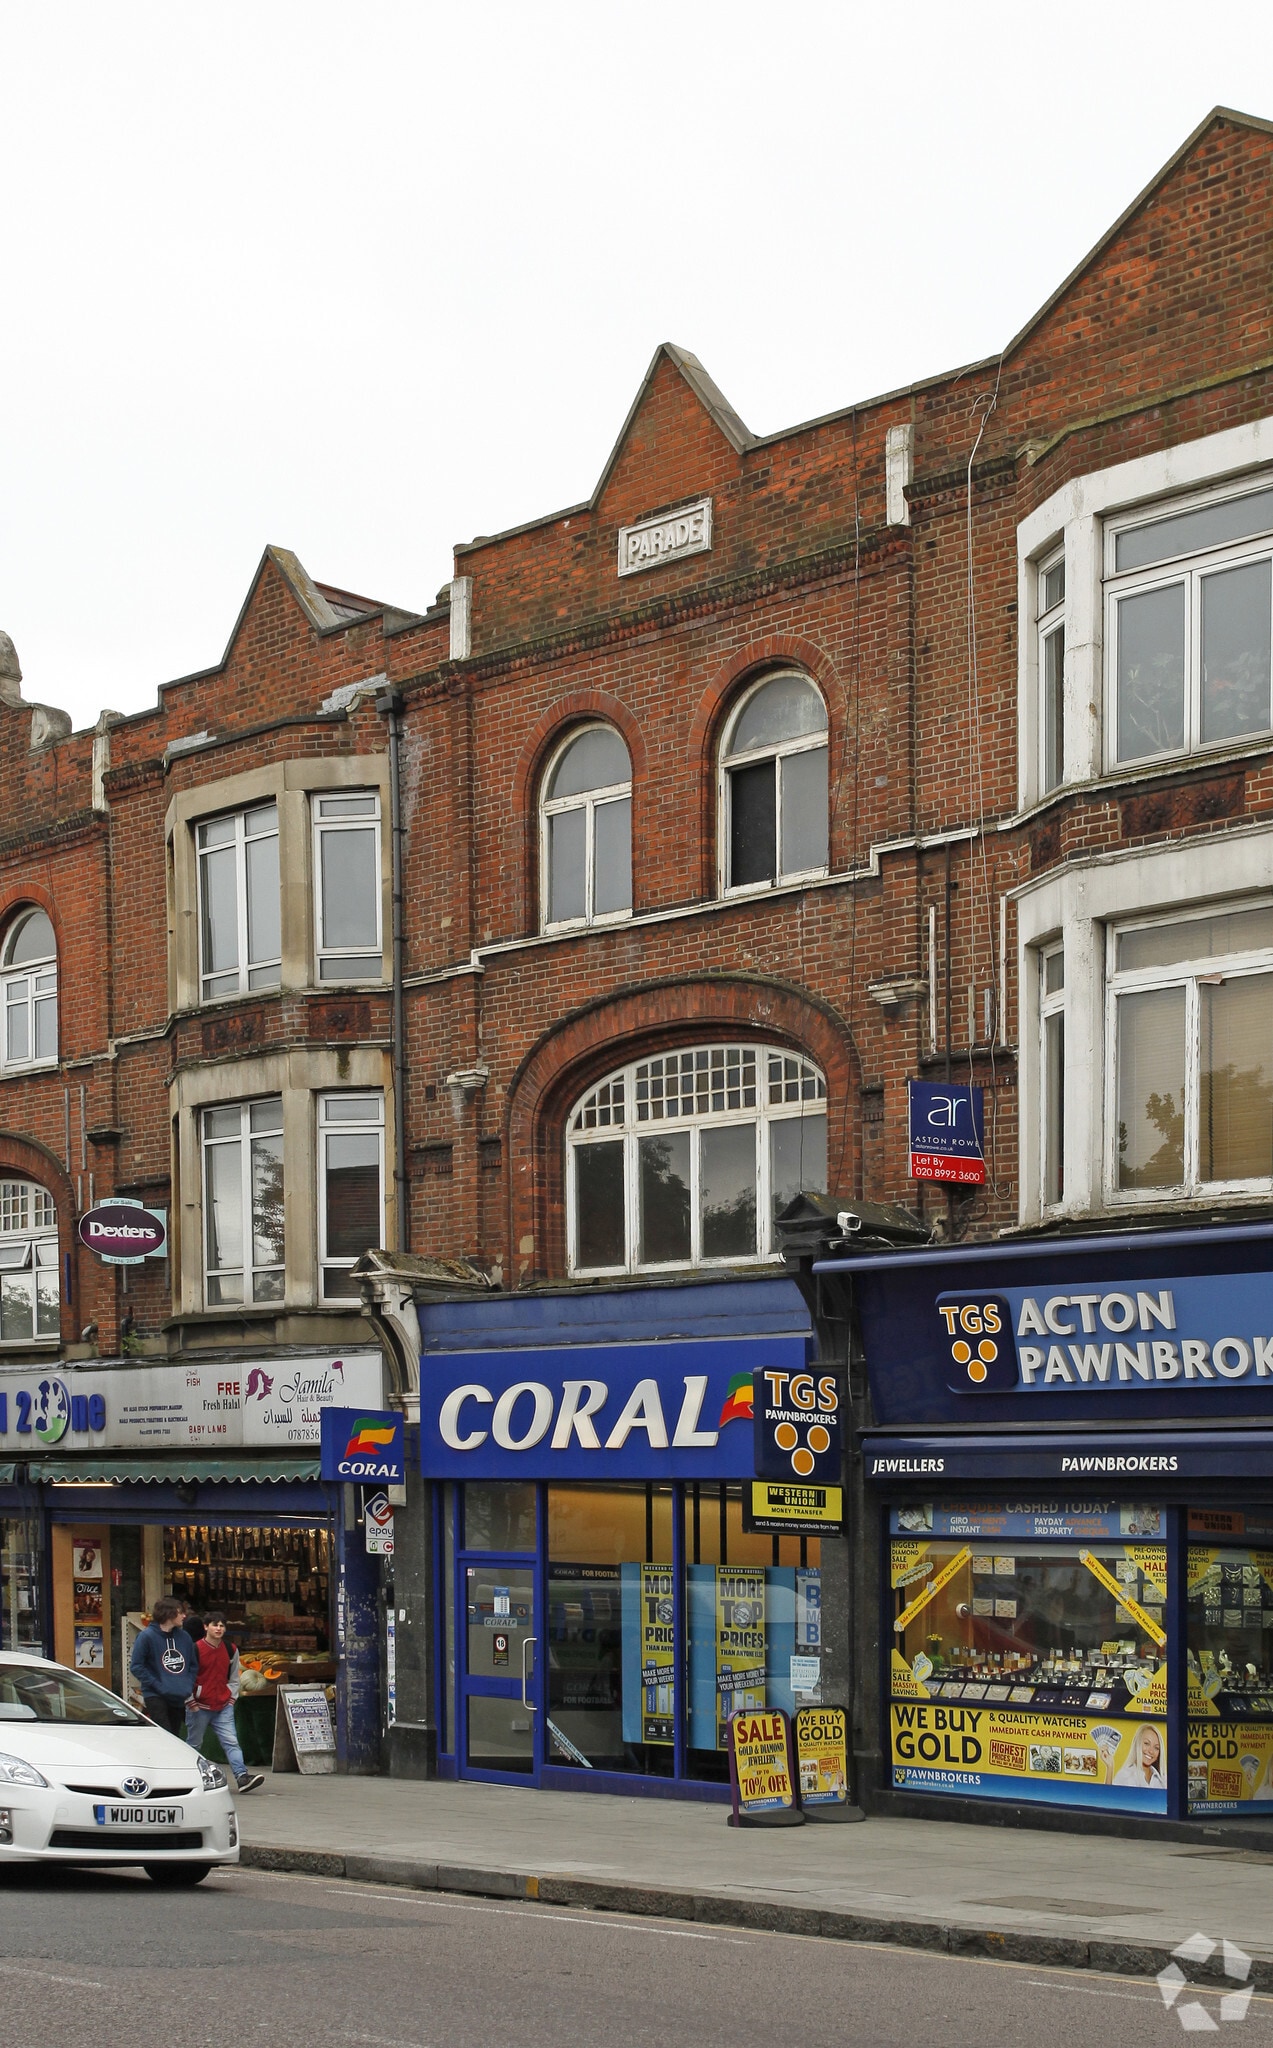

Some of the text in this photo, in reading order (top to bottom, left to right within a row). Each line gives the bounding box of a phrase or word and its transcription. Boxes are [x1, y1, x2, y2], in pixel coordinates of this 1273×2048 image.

[628, 516, 704, 565] PARADE
[915, 1136, 980, 1147] ASTON ROWE
[916, 1156, 944, 1167] Let By
[915, 1167, 980, 1181] 020 8992 3600
[89, 1221, 157, 1239] Dexters
[939, 1303, 1002, 1335] TGS
[1017, 1290, 1176, 1337] ACTON
[1018, 1335, 1273, 1384] PAWNBROK
[186, 1378, 201, 1387] FISH
[279, 1371, 335, 1403] Jamila
[764, 1370, 839, 1413] TGS
[297, 1394, 334, 1403] Hair & Beauty
[203, 1399, 241, 1411] Fresh Halal
[16, 1391, 31, 1433] 2
[439, 1375, 720, 1451] CORAL
[765, 1409, 837, 1425] PAWNBROKERS
[189, 1424, 227, 1434] BABY LAMB
[337, 1461, 400, 1477] CORAL
[872, 1458, 945, 1474] JEWELLERS
[1061, 1456, 1178, 1472] PAWNBROKERS
[768, 1487, 815, 1498] WESTERN
[784, 1496, 815, 1506] UNION
[771, 1507, 823, 1516] MONEY TRANSFER
[1005, 1503, 1059, 1514] CASHED
[1065, 1503, 1110, 1514] TODAY
[1034, 1518, 1064, 1526] PAYDAY
[1191, 1512, 1232, 1523] WESTERN
[369, 1526, 394, 1538] epay
[785, 1522, 799, 1530] money
[950, 1526, 981, 1534] INSTANT
[1034, 1527, 1049, 1535] 3RD
[1049, 1527, 1073, 1535] PARTY
[1204, 1521, 1233, 1531] UNION
[582, 1569, 594, 1577] FOR
[720, 1578, 763, 1598] MORE
[1126, 1600, 1138, 1612] Half
[485, 1618, 512, 1627] CORAL
[497, 1639, 505, 1648] 18
[720, 1631, 763, 1649] PRICES
[721, 1649, 735, 1657] THAN
[736, 1650, 755, 1658] ANYONE
[642, 1667, 670, 1678] MAKE MORE
[717, 1674, 732, 1684] MAKE
[732, 1671, 746, 1681] MORE
[892, 1673, 911, 1681] SALE
[644, 1676, 658, 1685] YOUR
[720, 1681, 734, 1691] YOUR
[288, 1696, 326, 1705] Lycamobile
[799, 1715, 842, 1726] WE BUY
[894, 1706, 983, 1733] WE BUY
[989, 1712, 1087, 1728] & QUALITY WATCHES
[737, 1718, 783, 1744] SALE
[799, 1726, 843, 1741] GOLD
[989, 1726, 1087, 1740] IMMEDIATE CASH PAYMENT
[1188, 1724, 1238, 1738] WE BUY
[738, 1743, 784, 1756] GOLD & DIAMOND
[895, 1730, 982, 1764] GOLD
[991, 1742, 1025, 1758] HIGHEST
[1188, 1740, 1238, 1759] GOLD
[748, 1754, 776, 1767] JEWELLERY
[991, 1753, 1024, 1765] PRICES PAID
[906, 1769, 981, 1785] PAWNBROKERS
[1212, 1773, 1240, 1785] HIGHEST
[742, 1775, 787, 1796] 70% OFF
[748, 1797, 778, 1805] PAWNBROKERS
[110, 1808, 176, 1824] WU10 UGW
